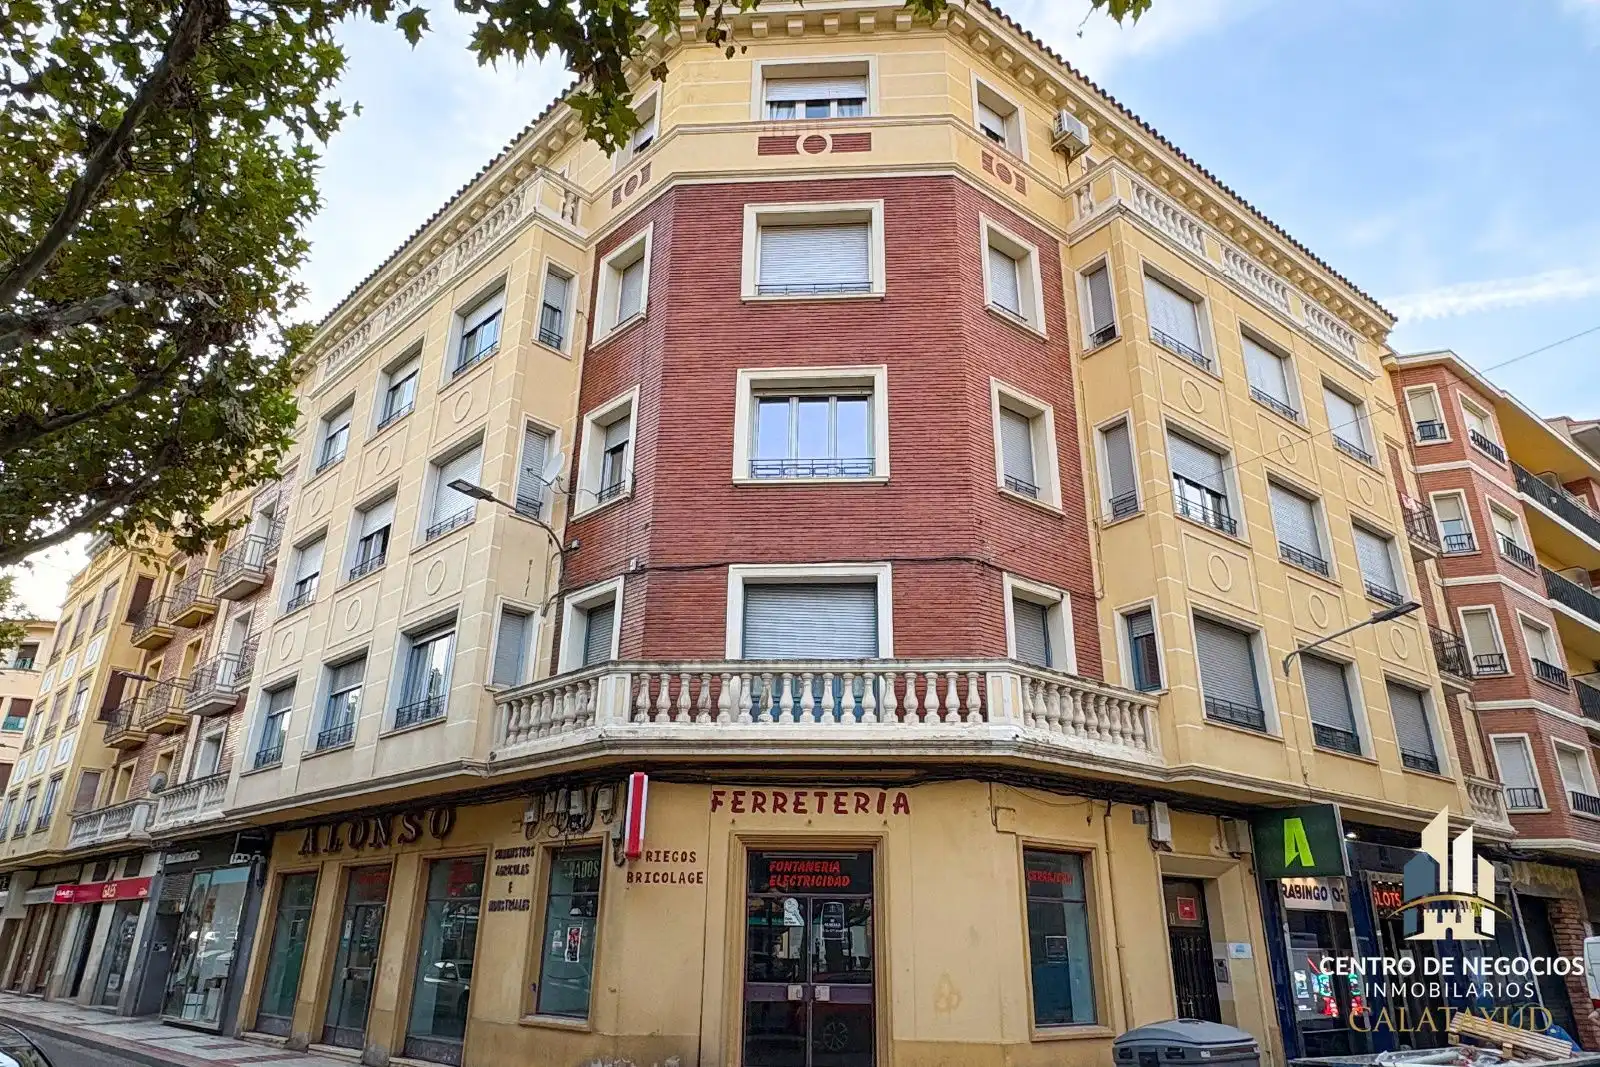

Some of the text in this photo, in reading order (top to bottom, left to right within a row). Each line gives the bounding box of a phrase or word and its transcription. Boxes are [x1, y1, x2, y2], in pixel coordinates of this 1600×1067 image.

[711, 790, 910, 815] FERRETERIA
[298, 806, 455, 857] ALONSO
[645, 850, 697, 863] RIEGOS
[626, 871, 704, 885] BRICOLAGE
[769, 874, 851, 888] ELECTRICIDAD
[507, 881, 513, 893] E
